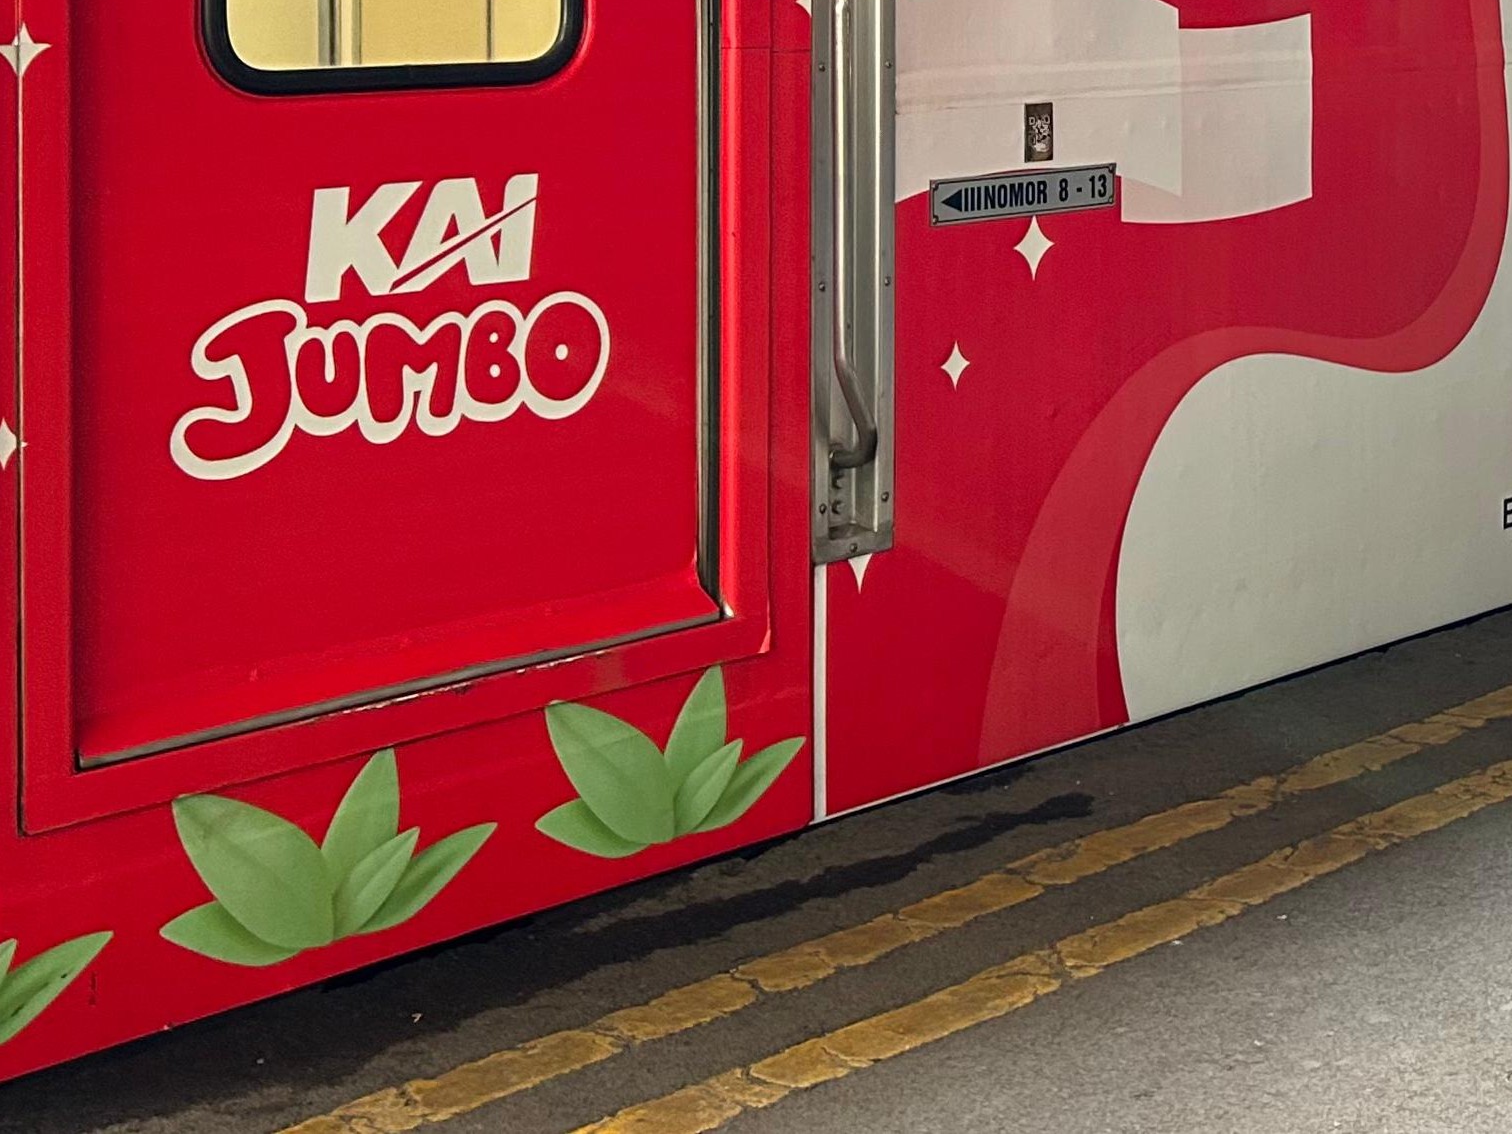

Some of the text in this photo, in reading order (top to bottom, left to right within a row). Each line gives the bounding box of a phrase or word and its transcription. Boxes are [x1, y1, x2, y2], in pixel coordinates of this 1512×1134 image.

[304, 173, 539, 303] KAI
[984, 180, 1047, 210] NOMOR
[1058, 178, 1069, 202] 8
[1089, 174, 1107, 198] 13
[170, 290, 611, 481] JUMBO
